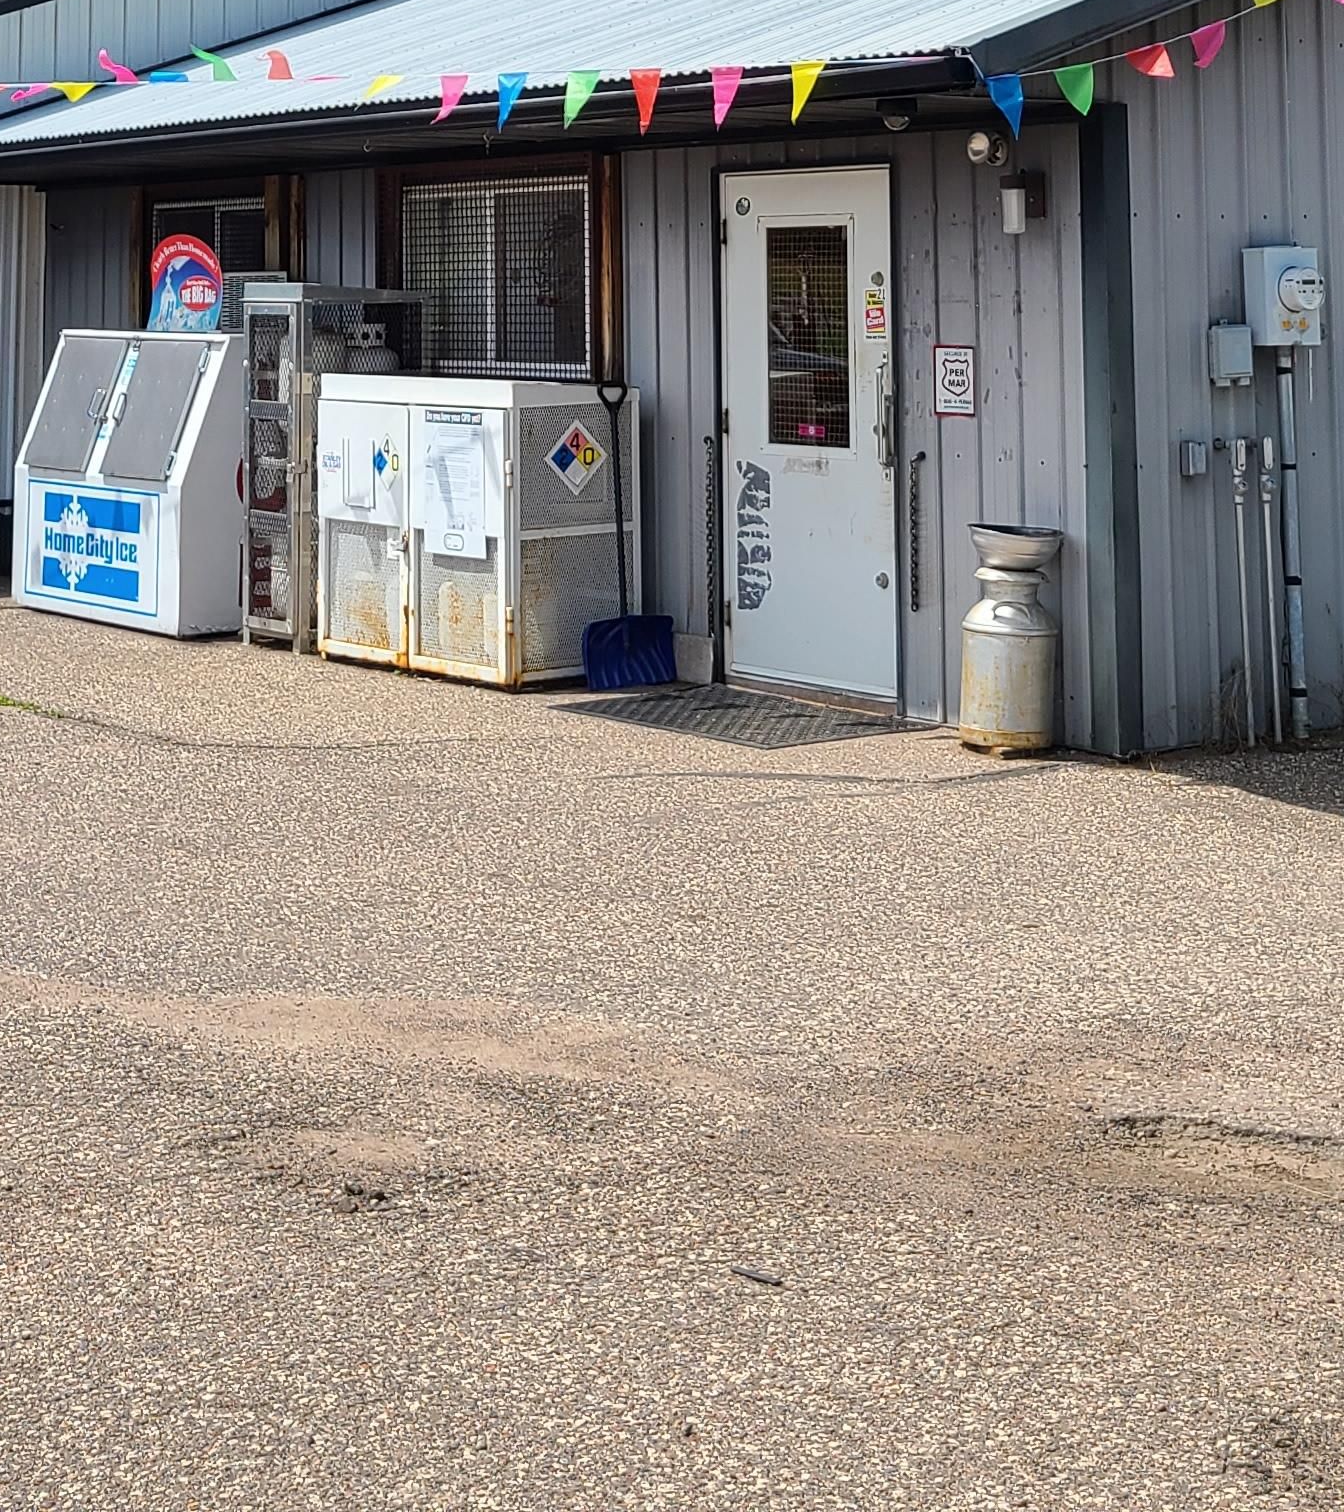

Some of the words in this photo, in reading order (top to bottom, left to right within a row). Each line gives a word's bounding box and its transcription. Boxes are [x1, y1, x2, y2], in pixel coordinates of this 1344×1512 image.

[192, 285, 203, 304] BIG
[204, 288, 216, 304] BAG
[949, 368, 965, 377] PER
[947, 379, 966, 388] MAR
[383, 438, 390, 457] 4
[569, 433, 581, 451] 4
[391, 453, 399, 472] 0
[583, 446, 595, 466] 0
[44, 526, 85, 555] Home
[85, 532, 113, 565] City
[115, 536, 138, 564] Ice
